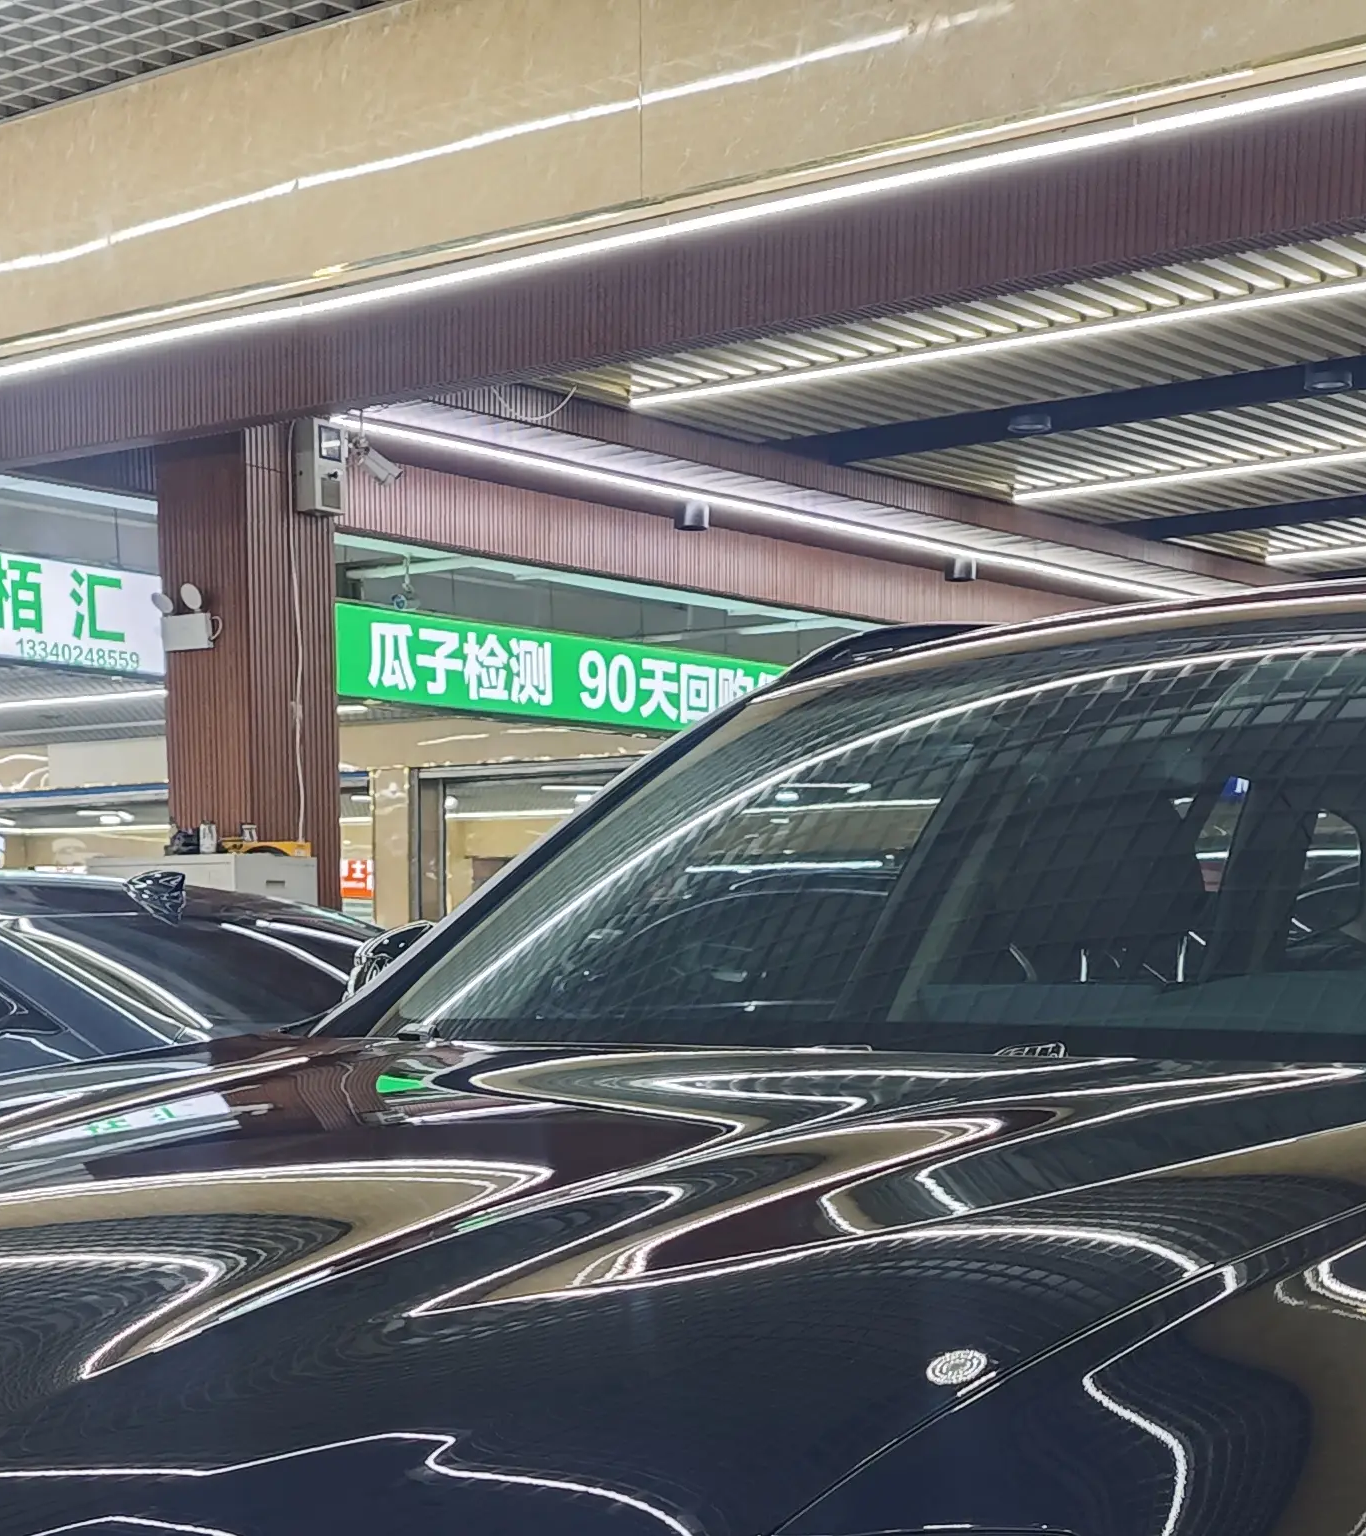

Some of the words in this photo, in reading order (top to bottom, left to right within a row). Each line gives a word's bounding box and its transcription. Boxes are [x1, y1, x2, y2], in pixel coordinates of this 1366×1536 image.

[15, 638, 141, 671] 13340248559
[367, 622, 553, 706] 瓜子检测
[578, 650, 781, 724] 90天回购
